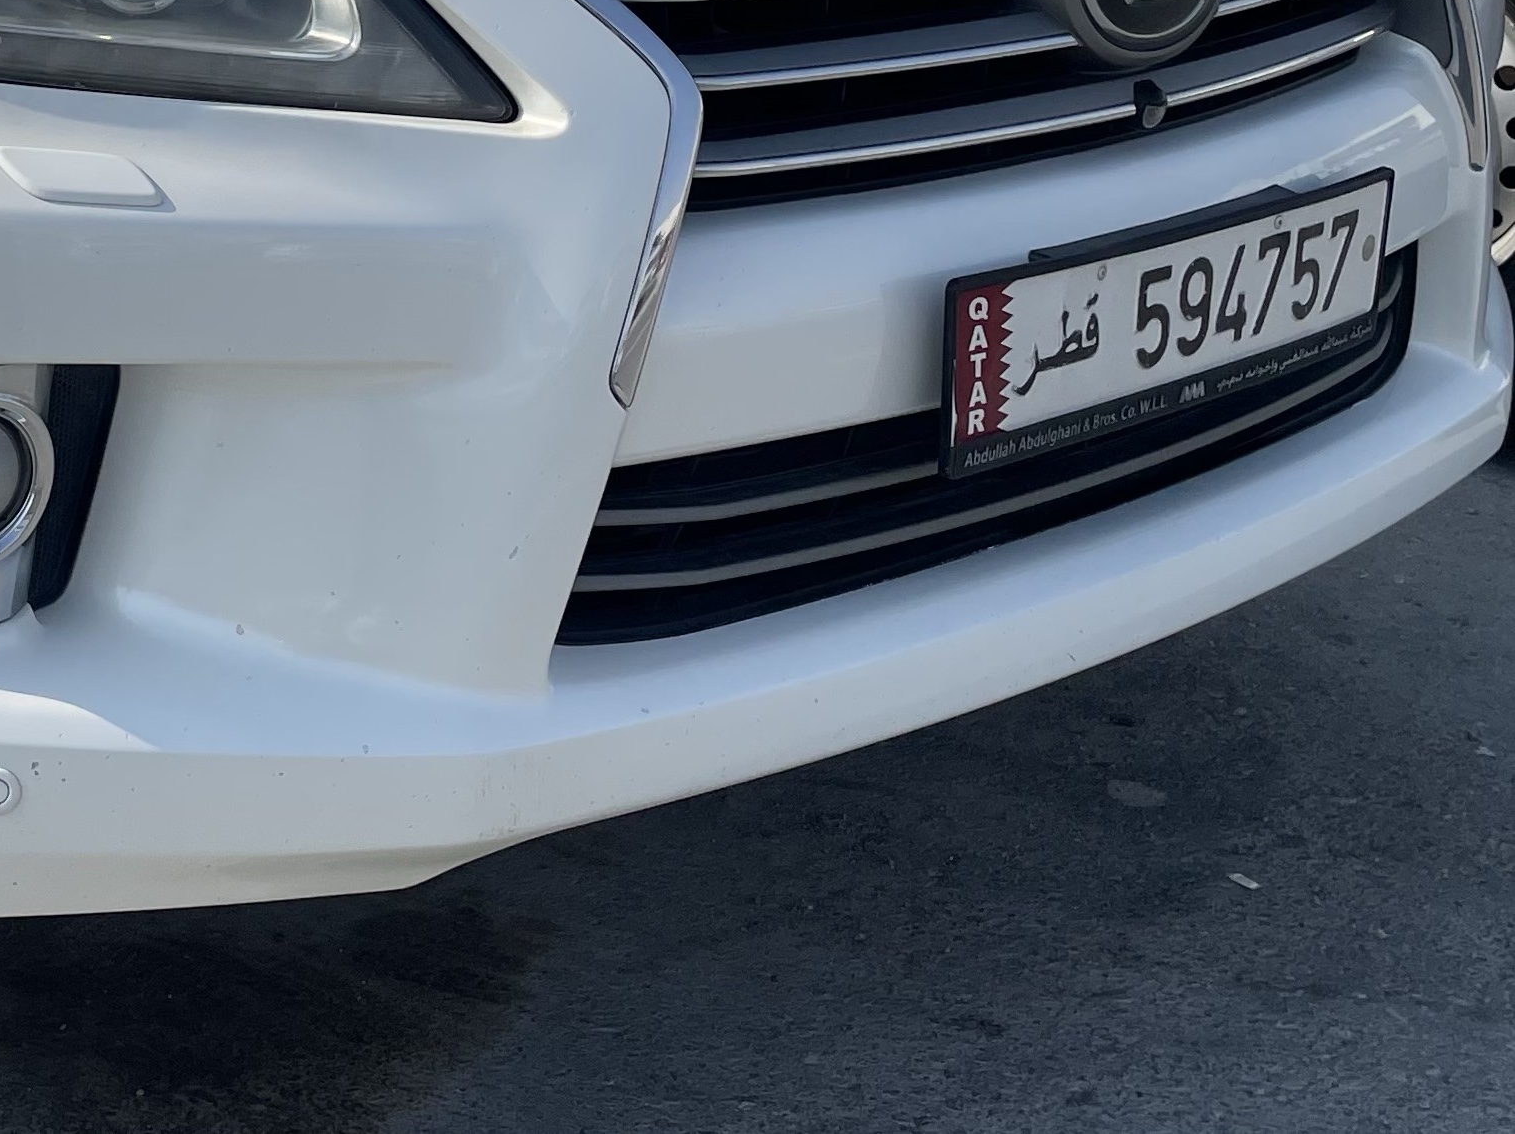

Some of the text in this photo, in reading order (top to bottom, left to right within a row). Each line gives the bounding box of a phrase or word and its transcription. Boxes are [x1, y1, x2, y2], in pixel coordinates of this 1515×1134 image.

[1011, 292, 1101, 397] قطر
[1133, 208, 1360, 370] 594757
[967, 295, 990, 436] QATAR
[964, 437, 1016, 468] Abdullah
[1018, 421, 1082, 453] Abdulghani
